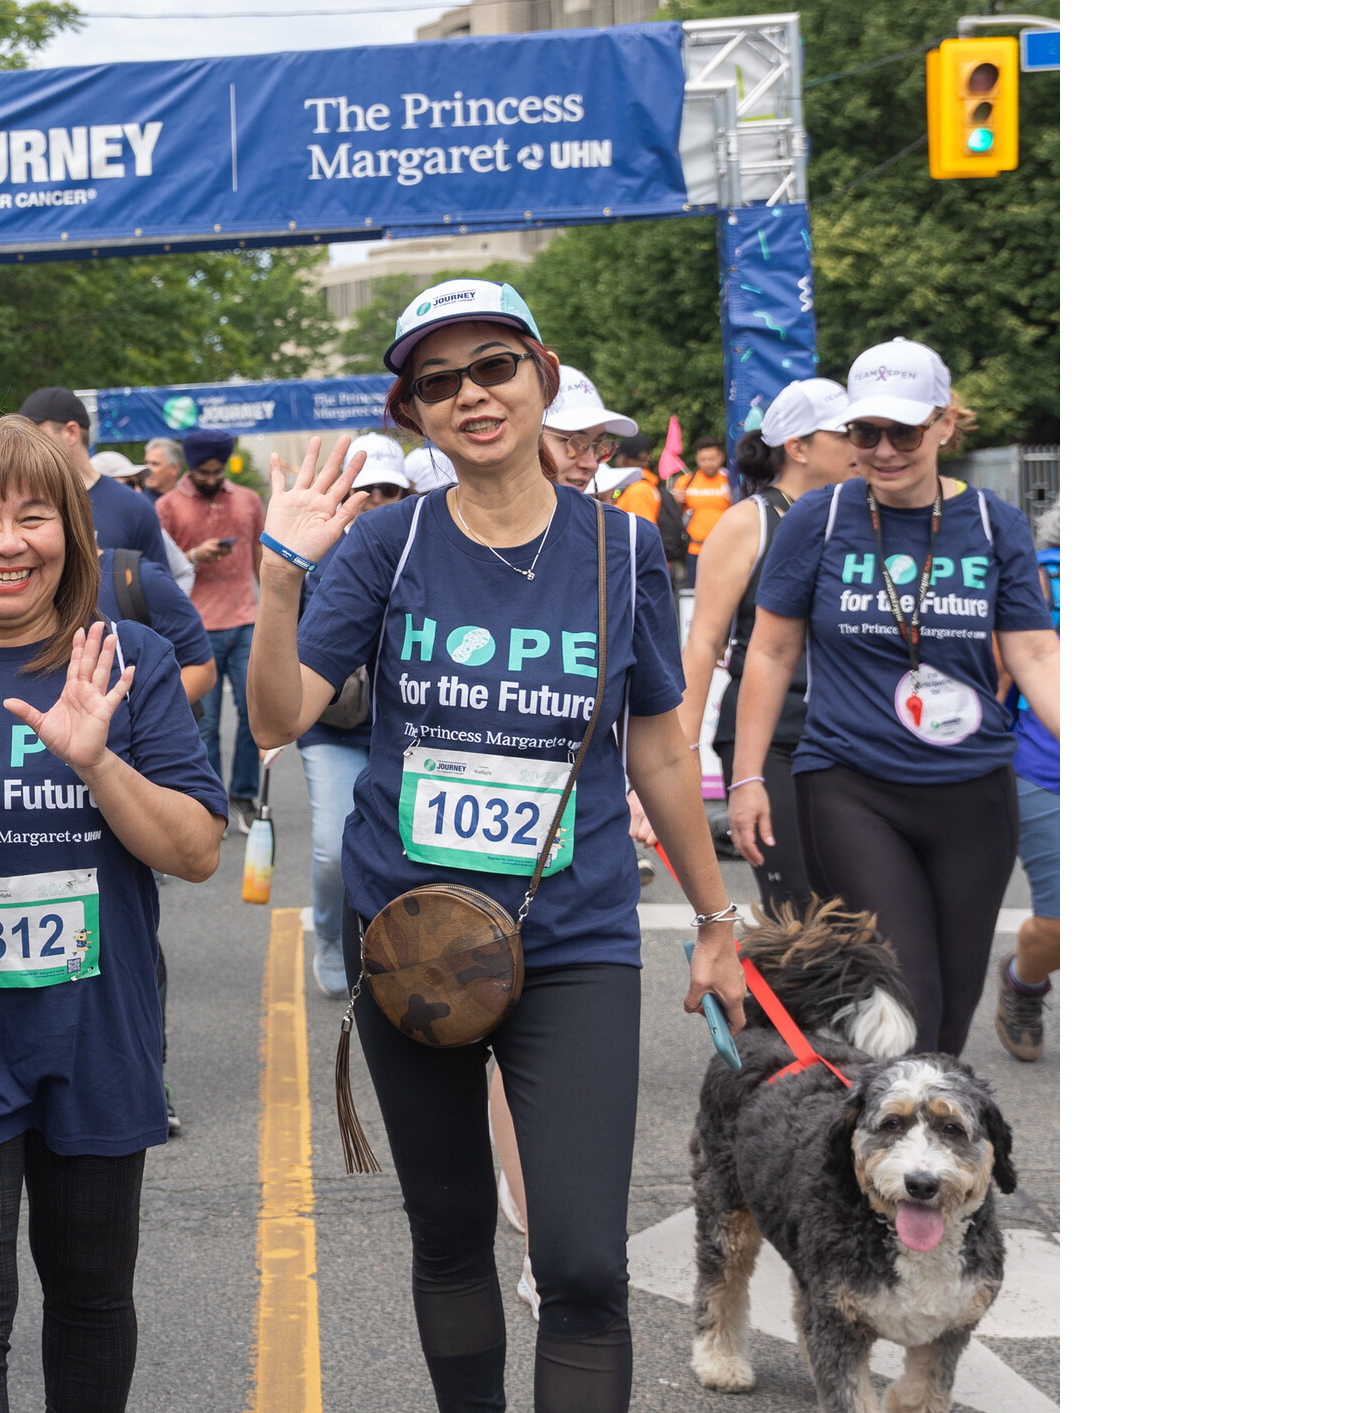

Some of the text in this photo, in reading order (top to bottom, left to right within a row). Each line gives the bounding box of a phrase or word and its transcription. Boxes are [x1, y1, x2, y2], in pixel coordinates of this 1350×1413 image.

[304, 90, 585, 134] The Princess
[307, 137, 613, 186] Margaret UHN
[432, 291, 476, 307] JOURNEY
[854, 370, 878, 381] TEAM
[841, 553, 989, 589] HOPE
[840, 589, 989, 618] for te Future
[838, 623, 859, 635] The
[861, 623, 899, 635] Prince
[400, 613, 598, 679] HOPE
[399, 673, 595, 721] for the Future
[404, 722, 418, 738] The
[420, 725, 482, 744] Princess
[485, 731, 558, 750] Margaret
[436, 763, 467, 773] JOURNEY
[428, 790, 540, 846] 1032
[84, 830, 102, 842] UHN
